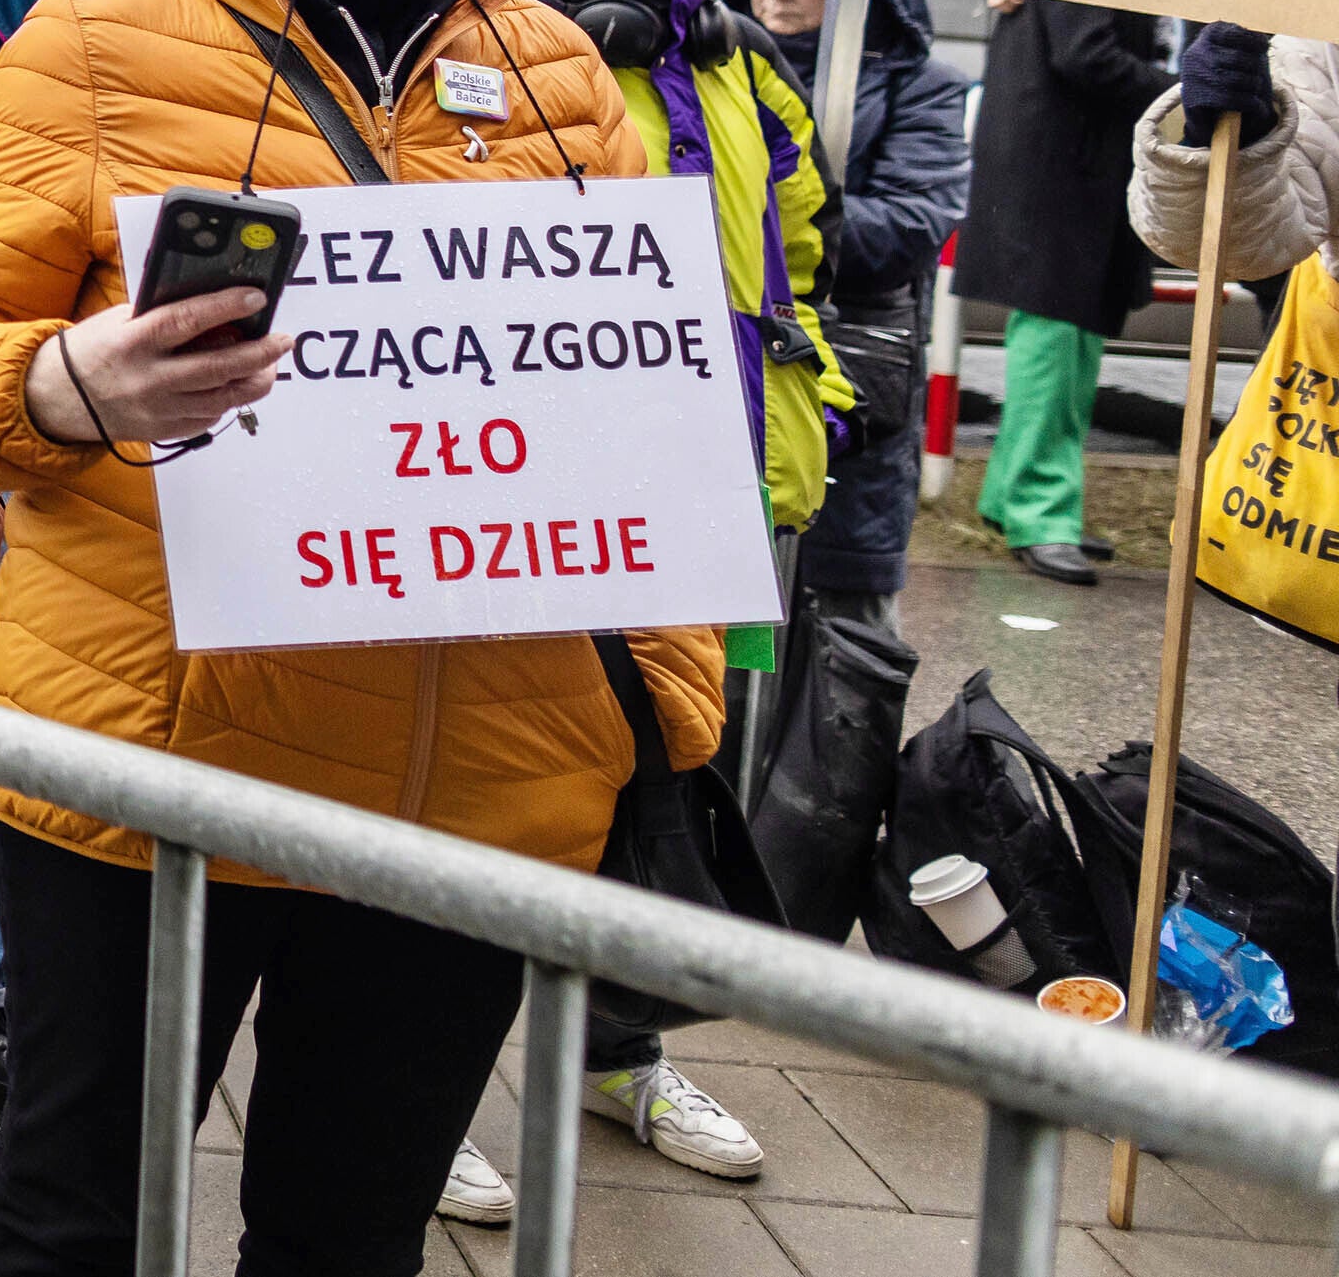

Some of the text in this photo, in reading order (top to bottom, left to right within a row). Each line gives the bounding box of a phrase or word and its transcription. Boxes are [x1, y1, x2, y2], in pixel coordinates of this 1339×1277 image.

[452, 70, 491, 87] Polskie
[455, 90, 492, 106] Babcie
[423, 223, 674, 289] WASZĄ
[507, 318, 713, 380] ZGODĘ
[390, 417, 528, 479] ZŁO
[297, 517, 655, 600] SIĘ DZIEJE
